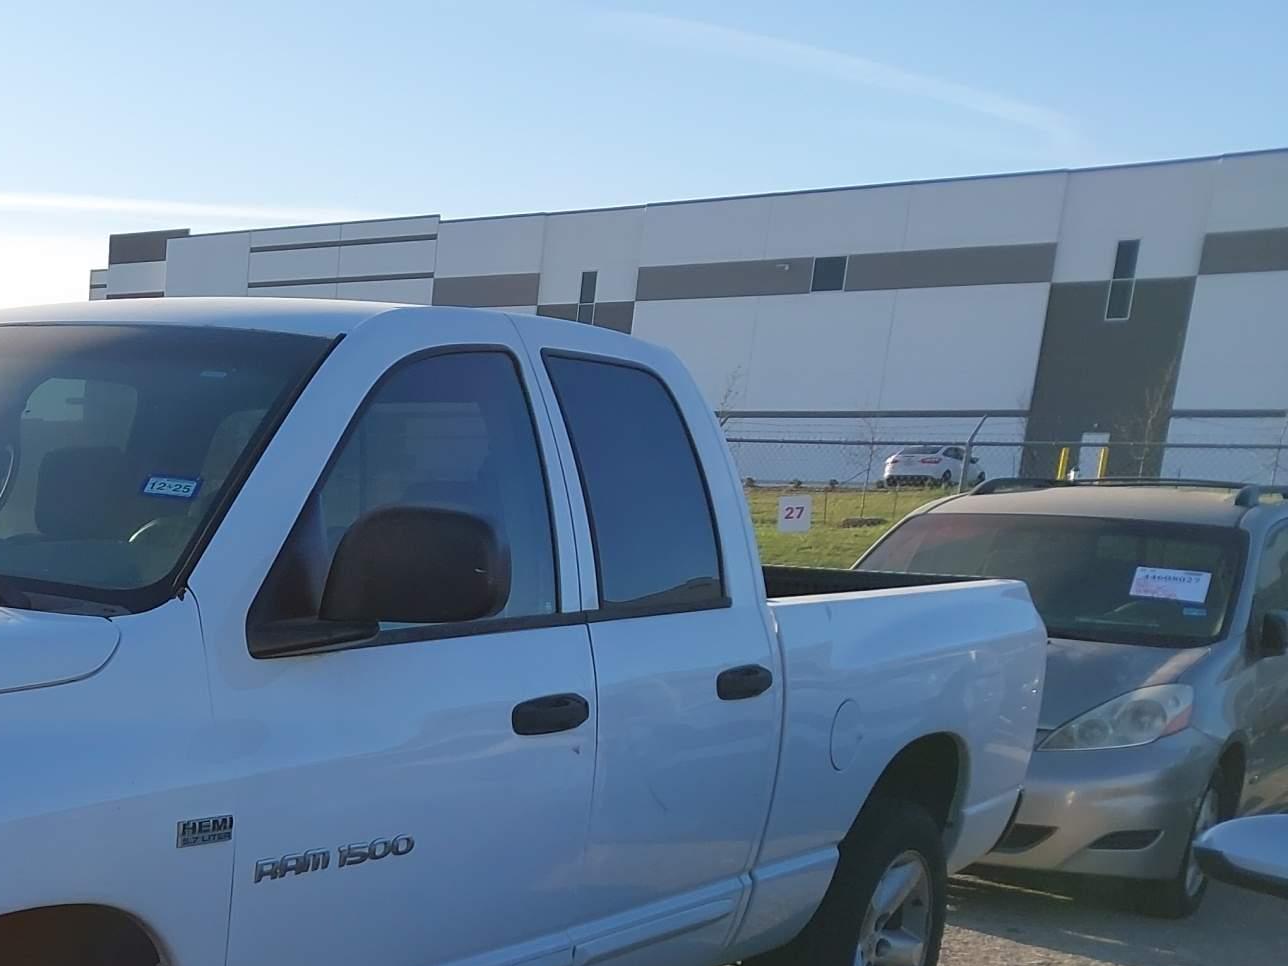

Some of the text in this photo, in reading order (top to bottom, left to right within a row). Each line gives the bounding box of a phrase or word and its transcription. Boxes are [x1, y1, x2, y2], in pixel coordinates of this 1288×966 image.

[784, 506, 805, 520] 27
[182, 816, 233, 834] HEMI
[254, 833, 415, 883] RAM 1500
